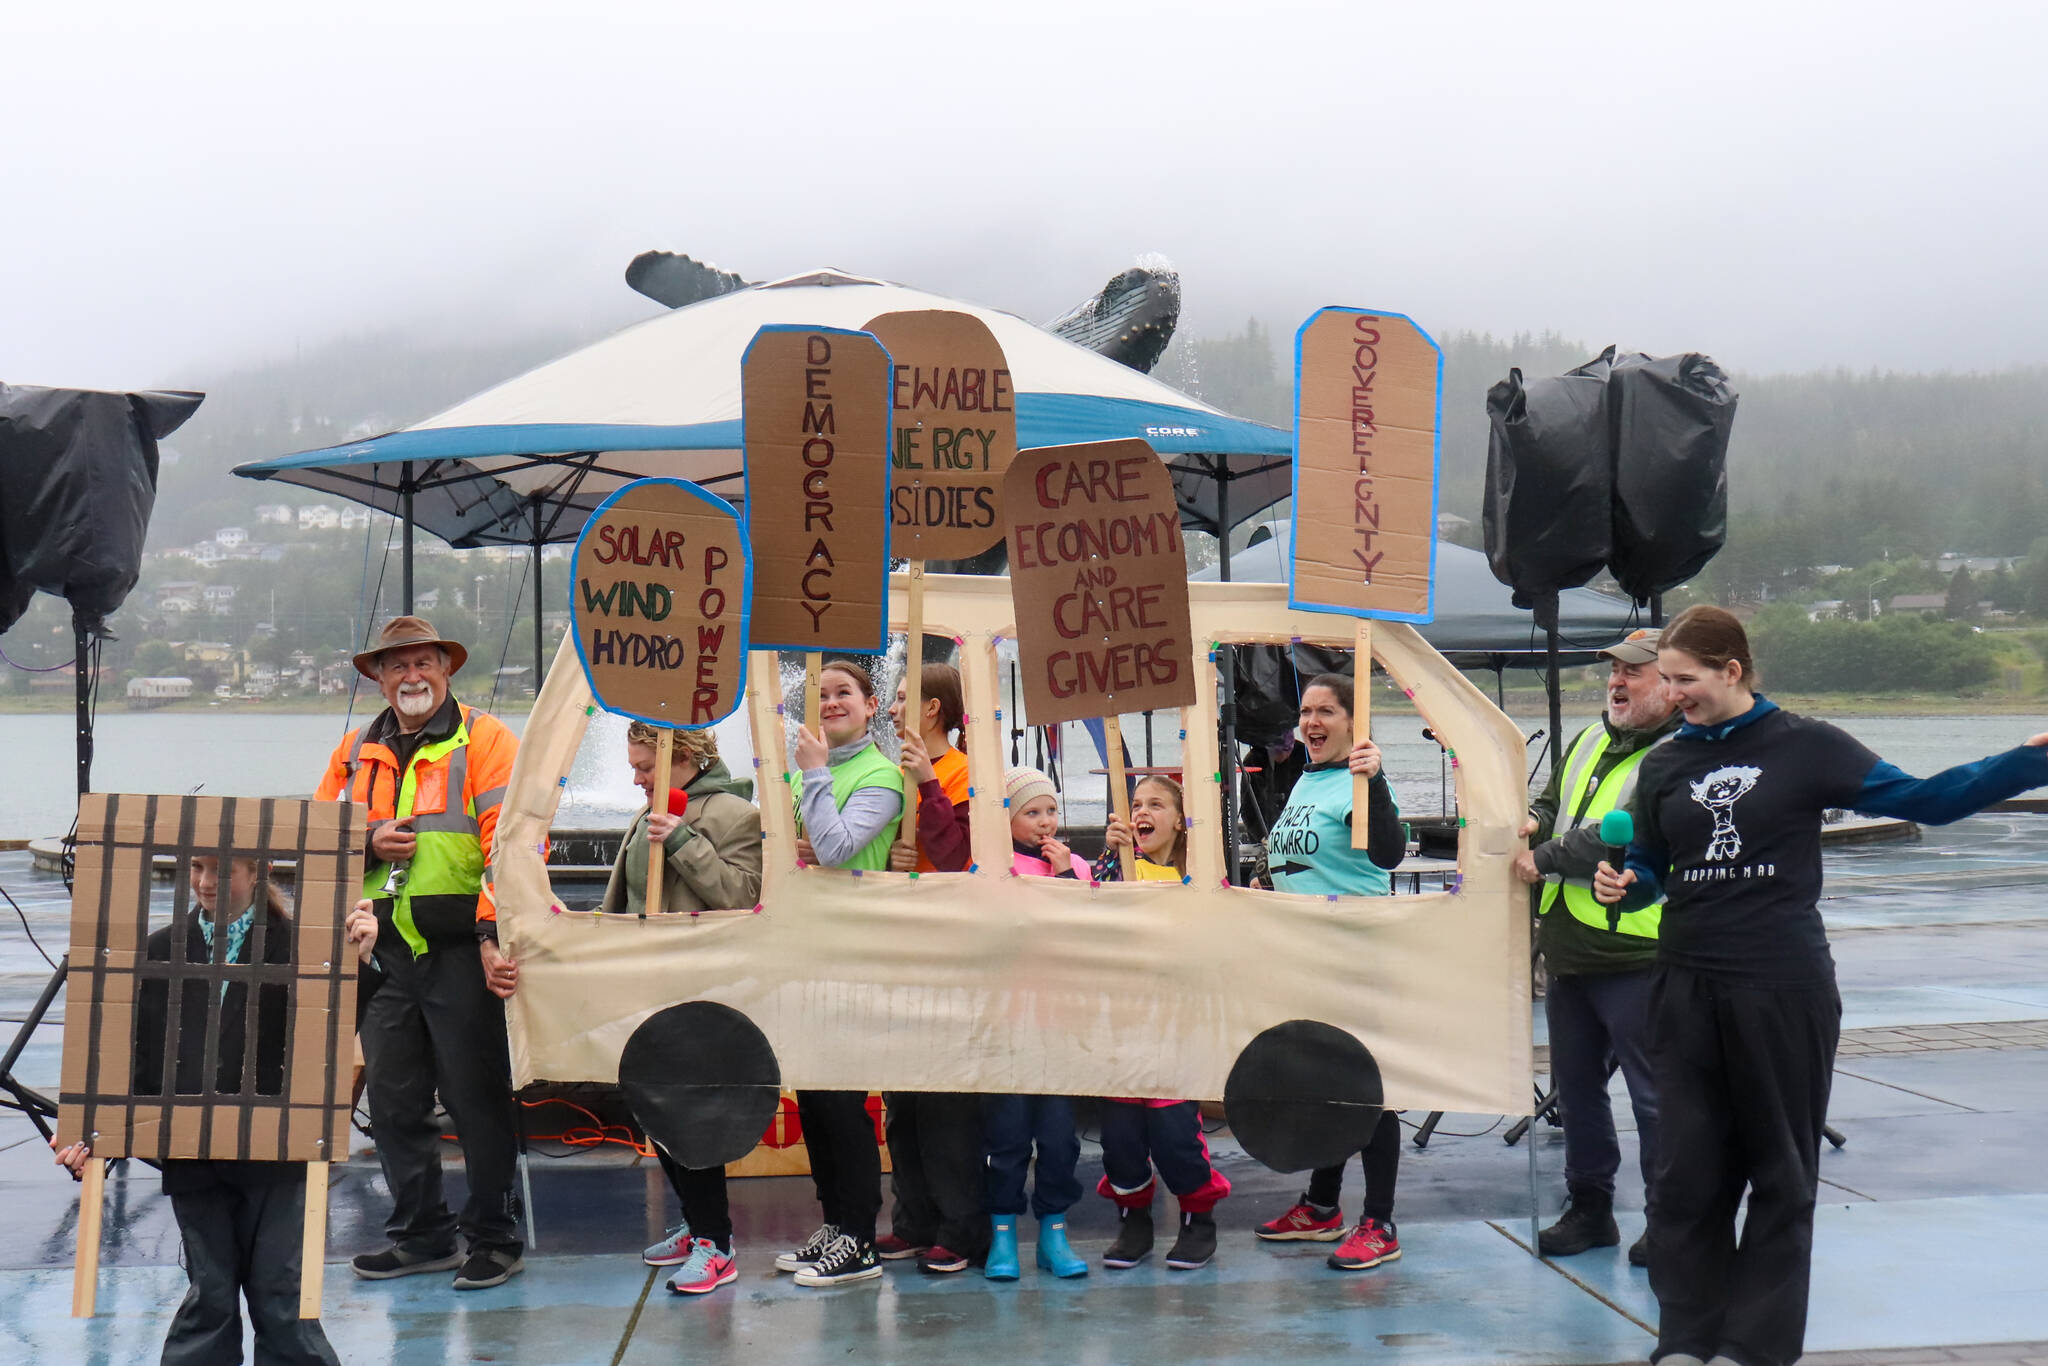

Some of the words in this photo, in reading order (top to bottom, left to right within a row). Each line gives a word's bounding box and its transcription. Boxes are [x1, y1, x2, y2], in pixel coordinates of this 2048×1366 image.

[893, 364, 1012, 412] EWABLE
[891, 427, 996, 470] NERGY
[1146, 427, 1198, 435] CORE
[1352, 316, 1384, 582] SOVEREIGNTY
[801, 335, 835, 632] DEMOCRACY
[1035, 457, 1150, 509] CARE
[890, 486, 995, 528] SIDIES
[593, 525, 685, 570] SOLAR
[1015, 511, 1179, 569] ECONOMY
[913, 567, 923, 580] 2
[1074, 567, 1117, 591] AND
[581, 578, 672, 621] WIND
[1053, 584, 1168, 639] CARE
[593, 628, 684, 670] HYDRO
[691, 546, 728, 724] POWER
[1046, 639, 1178, 698] GIVERS
[1269, 829, 1319, 855] ORWARD
[1683, 867, 1736, 881] HOPPING
